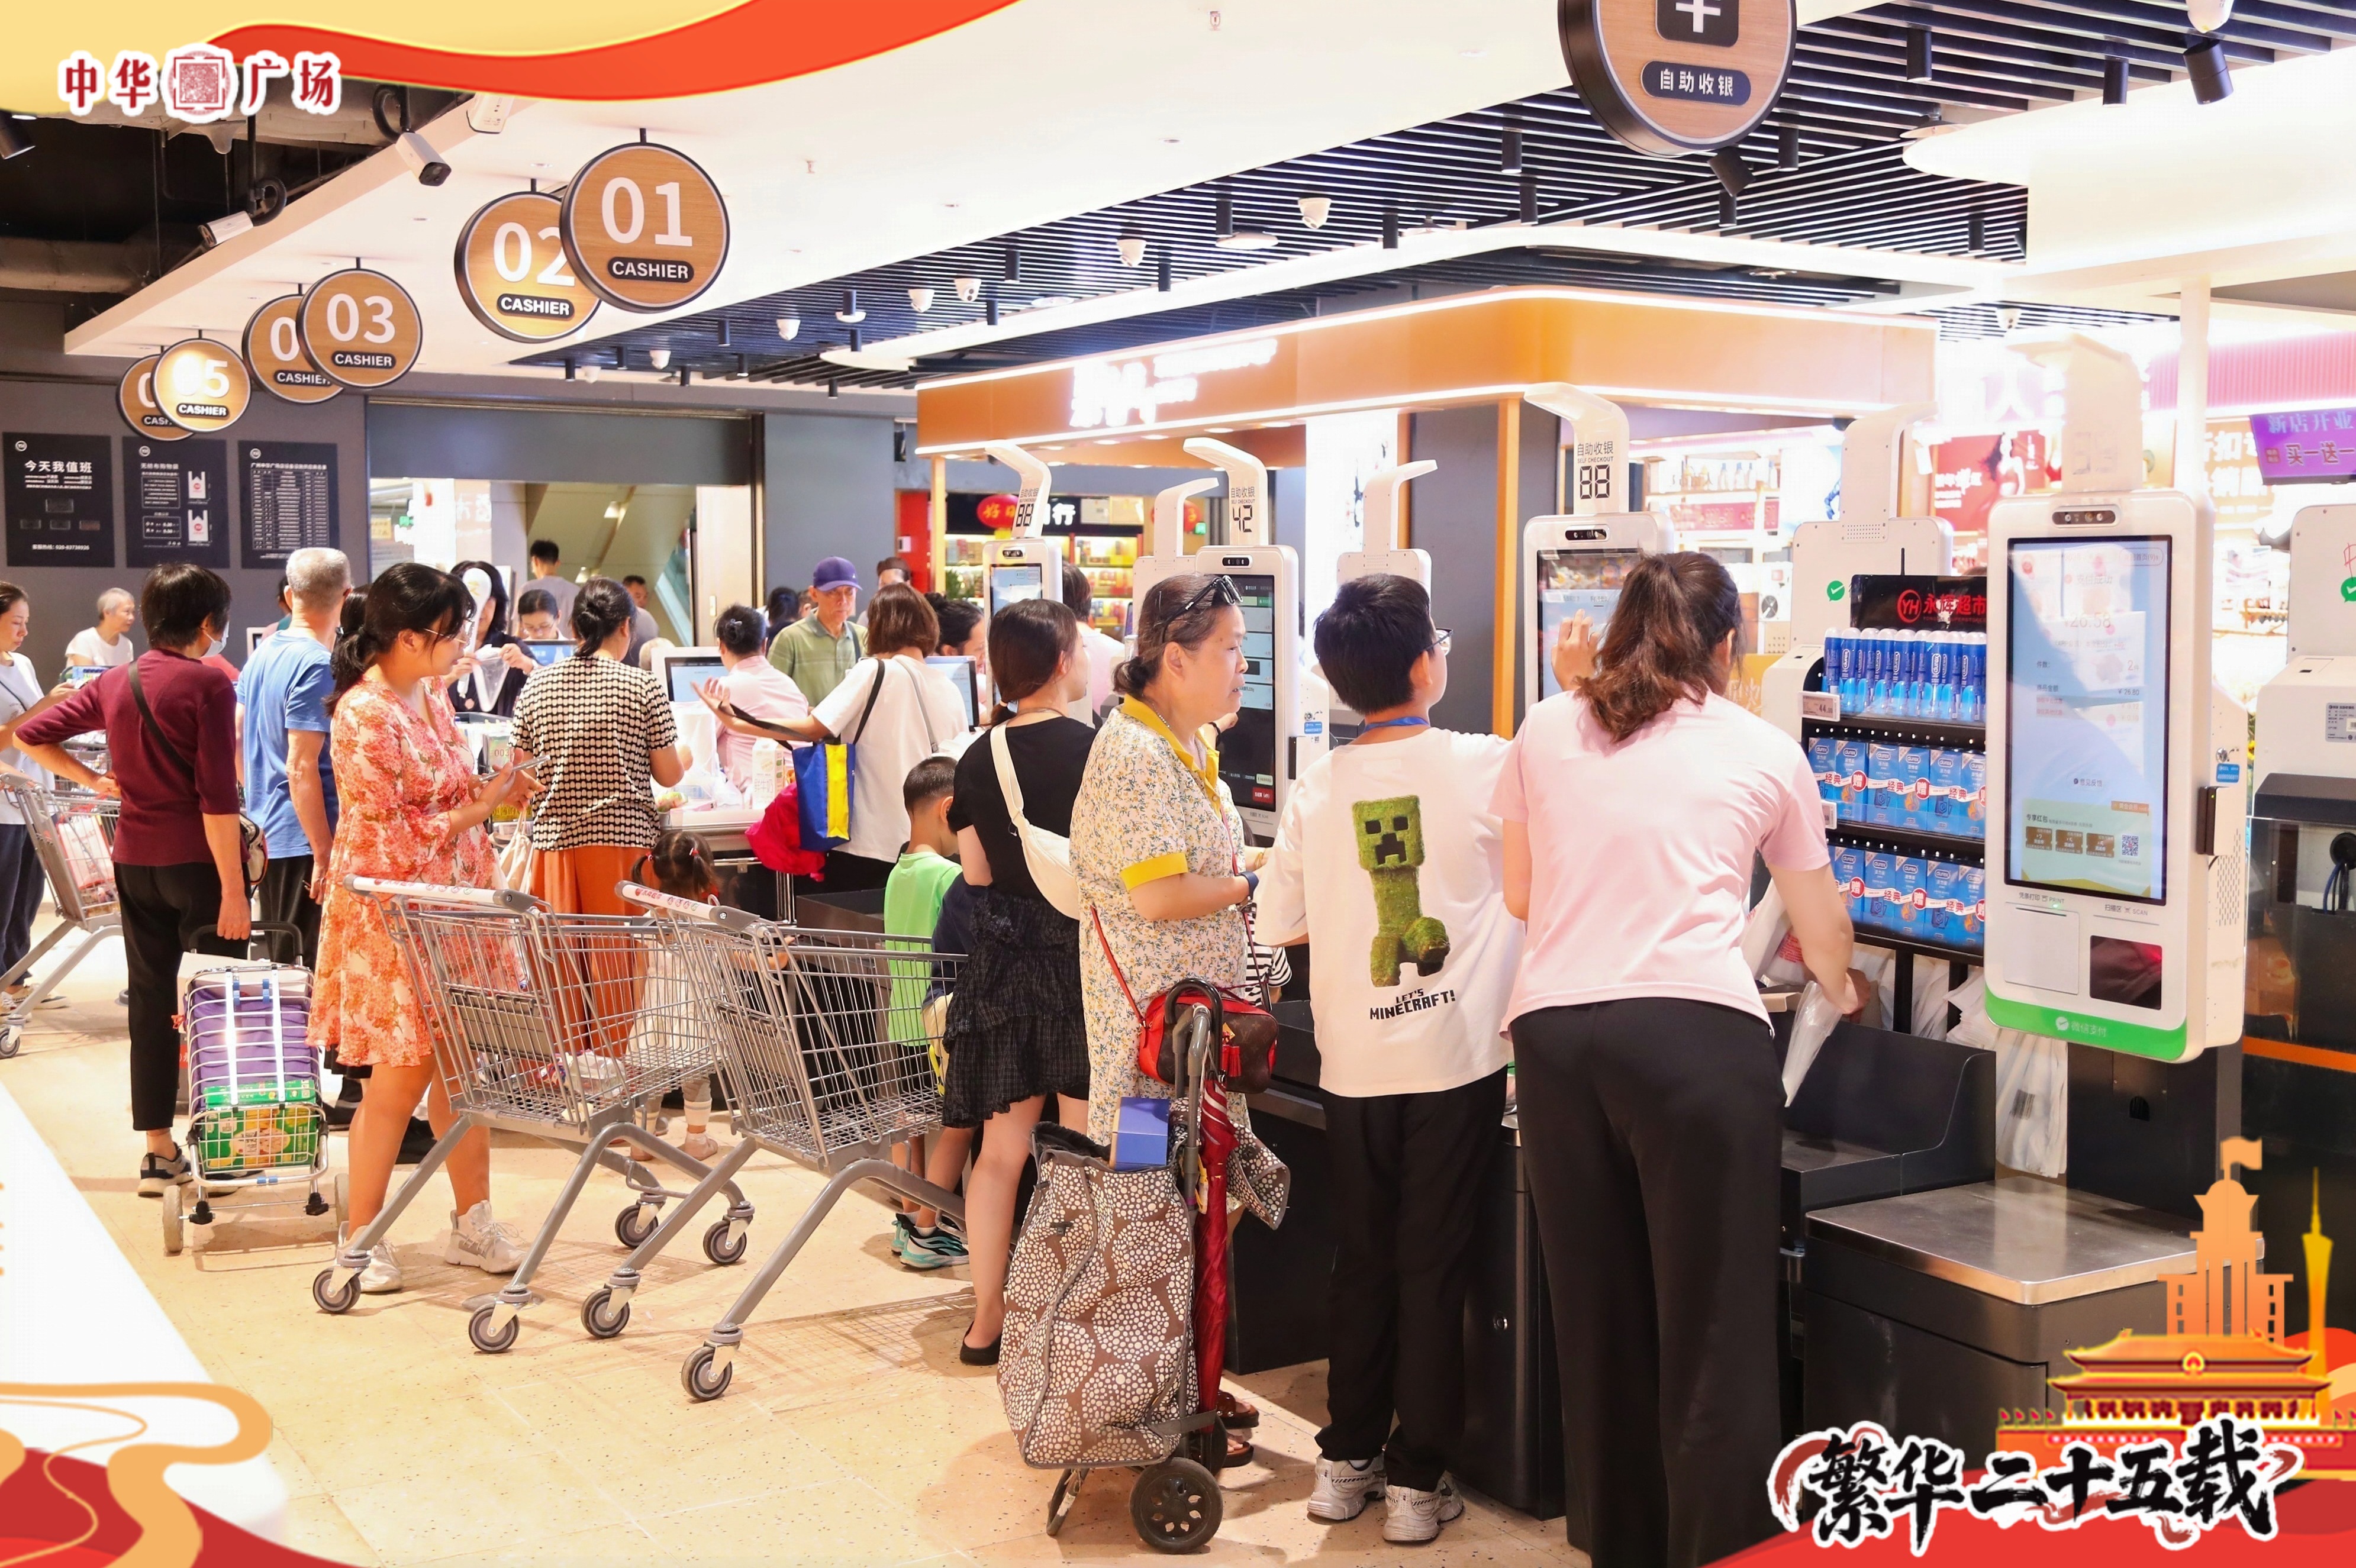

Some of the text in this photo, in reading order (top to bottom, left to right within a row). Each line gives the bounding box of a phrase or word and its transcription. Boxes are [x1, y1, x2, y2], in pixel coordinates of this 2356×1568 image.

[1660, 69, 1734, 96] 自助收银
[601, 177, 693, 247] 01
[493, 222, 576, 287] 02
[612, 261, 689, 279] CASHIER
[501, 296, 570, 316] CASHIER
[327, 293, 396, 344] 03
[270, 316, 300, 362] 0
[335, 354, 392, 367] CASHIER
[174, 356, 230, 398] 05
[178, 404, 227, 417] CASHIER
[2268, 411, 2354, 433] 新店开业
[1577, 441, 1613, 456] 自助收银
[2286, 441, 2355, 466] 买一送一
[25, 460, 92, 473] 今天我值班
[1580, 464, 1610, 499] 88
[1231, 486, 1255, 498] 自助收银
[1233, 505, 1253, 533] 42
[2077, 574, 2112, 585] 支付成功
[1902, 599, 1920, 615] YH
[1923, 592, 1987, 615] 永辉超市
[1825, 773, 1841, 784] 经典
[1853, 775, 1863, 788] 赠
[2080, 778, 2103, 787] 意见反馈
[1888, 781, 1904, 792] 经典
[1917, 782, 1927, 795] 赠
[1949, 788, 1967, 799] 经典
[2026, 814, 2048, 823] 专享红包
[1851, 881, 1861, 894] 赠
[1884, 890, 1901, 902] 经典
[1913, 892, 1924, 906] 赠
[2019, 892, 2041, 901] 凭条打印
[1946, 900, 1964, 912] 经典
[2104, 904, 2122, 913] 扫描区
[1395, 988, 1424, 1004] LET'S
[1369, 989, 1456, 1020] MINECRAFT!
[2071, 1021, 2107, 1037] 微信支付
